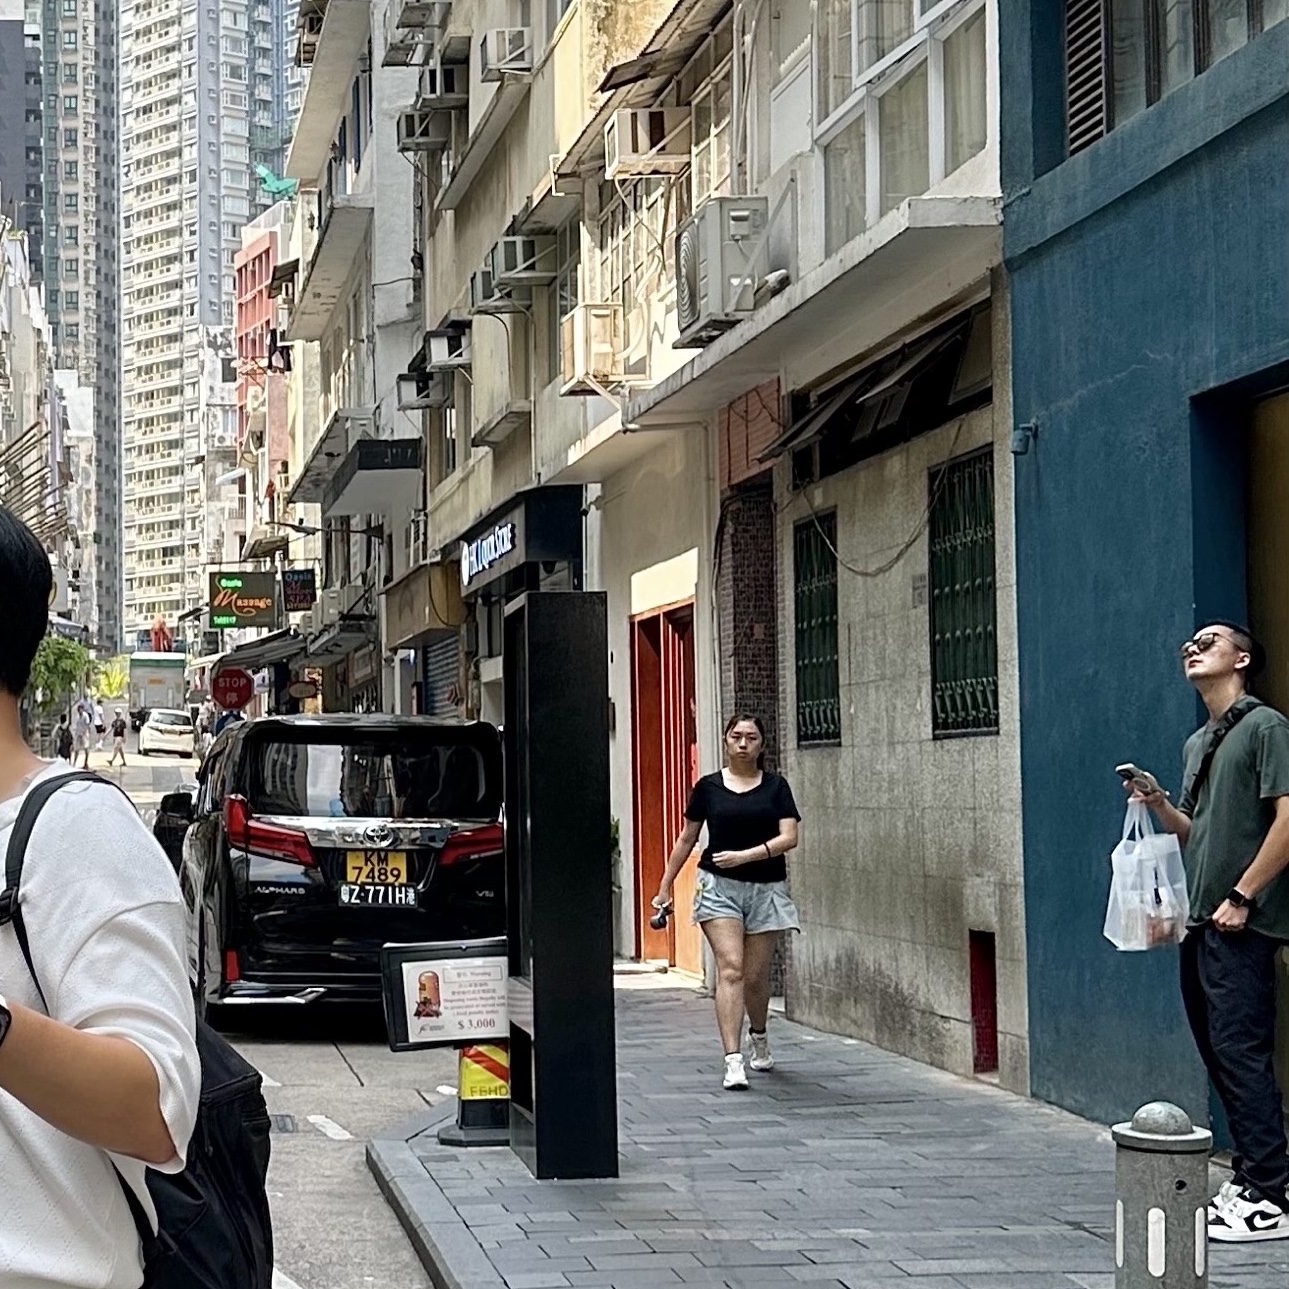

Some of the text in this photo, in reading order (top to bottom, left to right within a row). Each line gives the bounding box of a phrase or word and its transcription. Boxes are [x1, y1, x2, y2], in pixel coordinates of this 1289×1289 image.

[213, 579, 272, 616] Massage
[218, 677, 247, 688] STOP
[225, 692, 239, 704] 停
[364, 850, 389, 867] KM
[352, 866, 402, 882] 7489
[458, 1018, 496, 1029] $ 3,000
